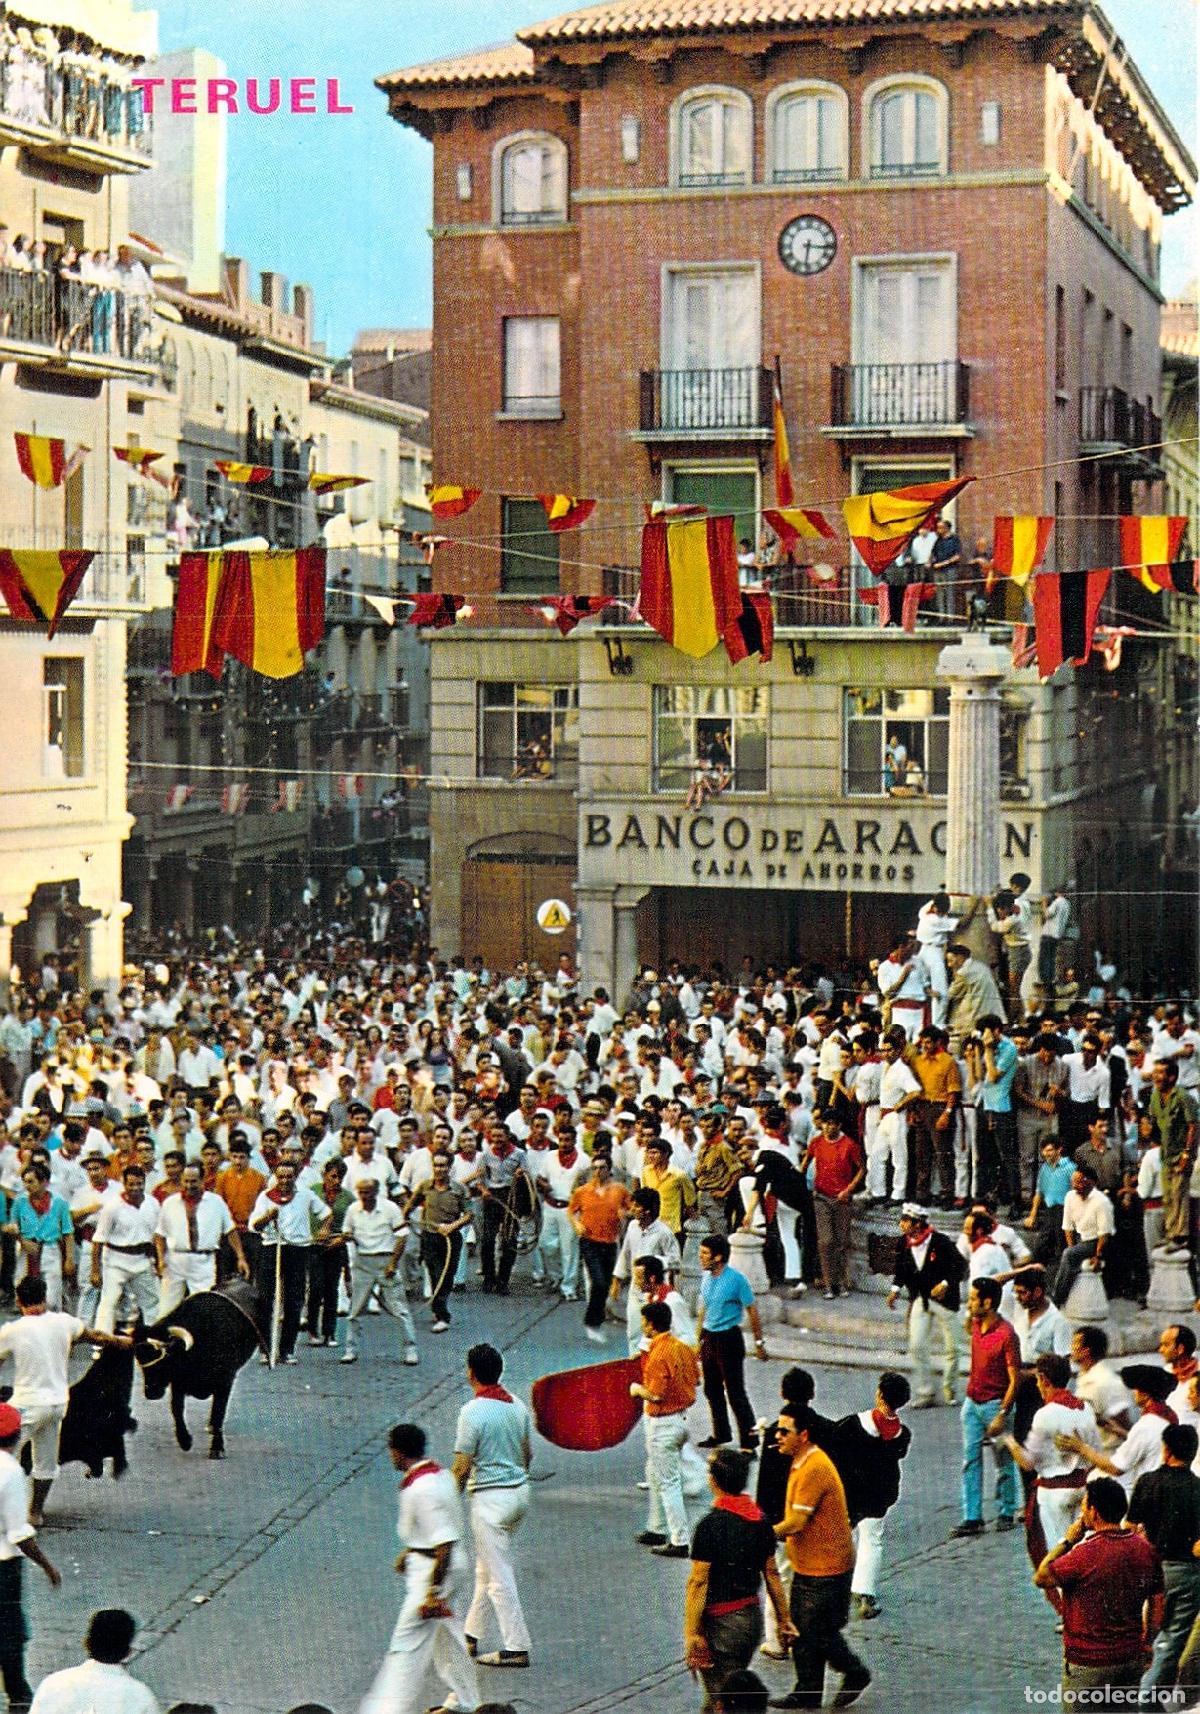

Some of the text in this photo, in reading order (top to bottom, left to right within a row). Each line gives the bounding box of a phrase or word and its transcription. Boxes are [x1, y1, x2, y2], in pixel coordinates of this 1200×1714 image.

[585, 814, 1033, 858] BANCO DE ARAN
[692, 859, 915, 881] CAJA DE AHORROS
